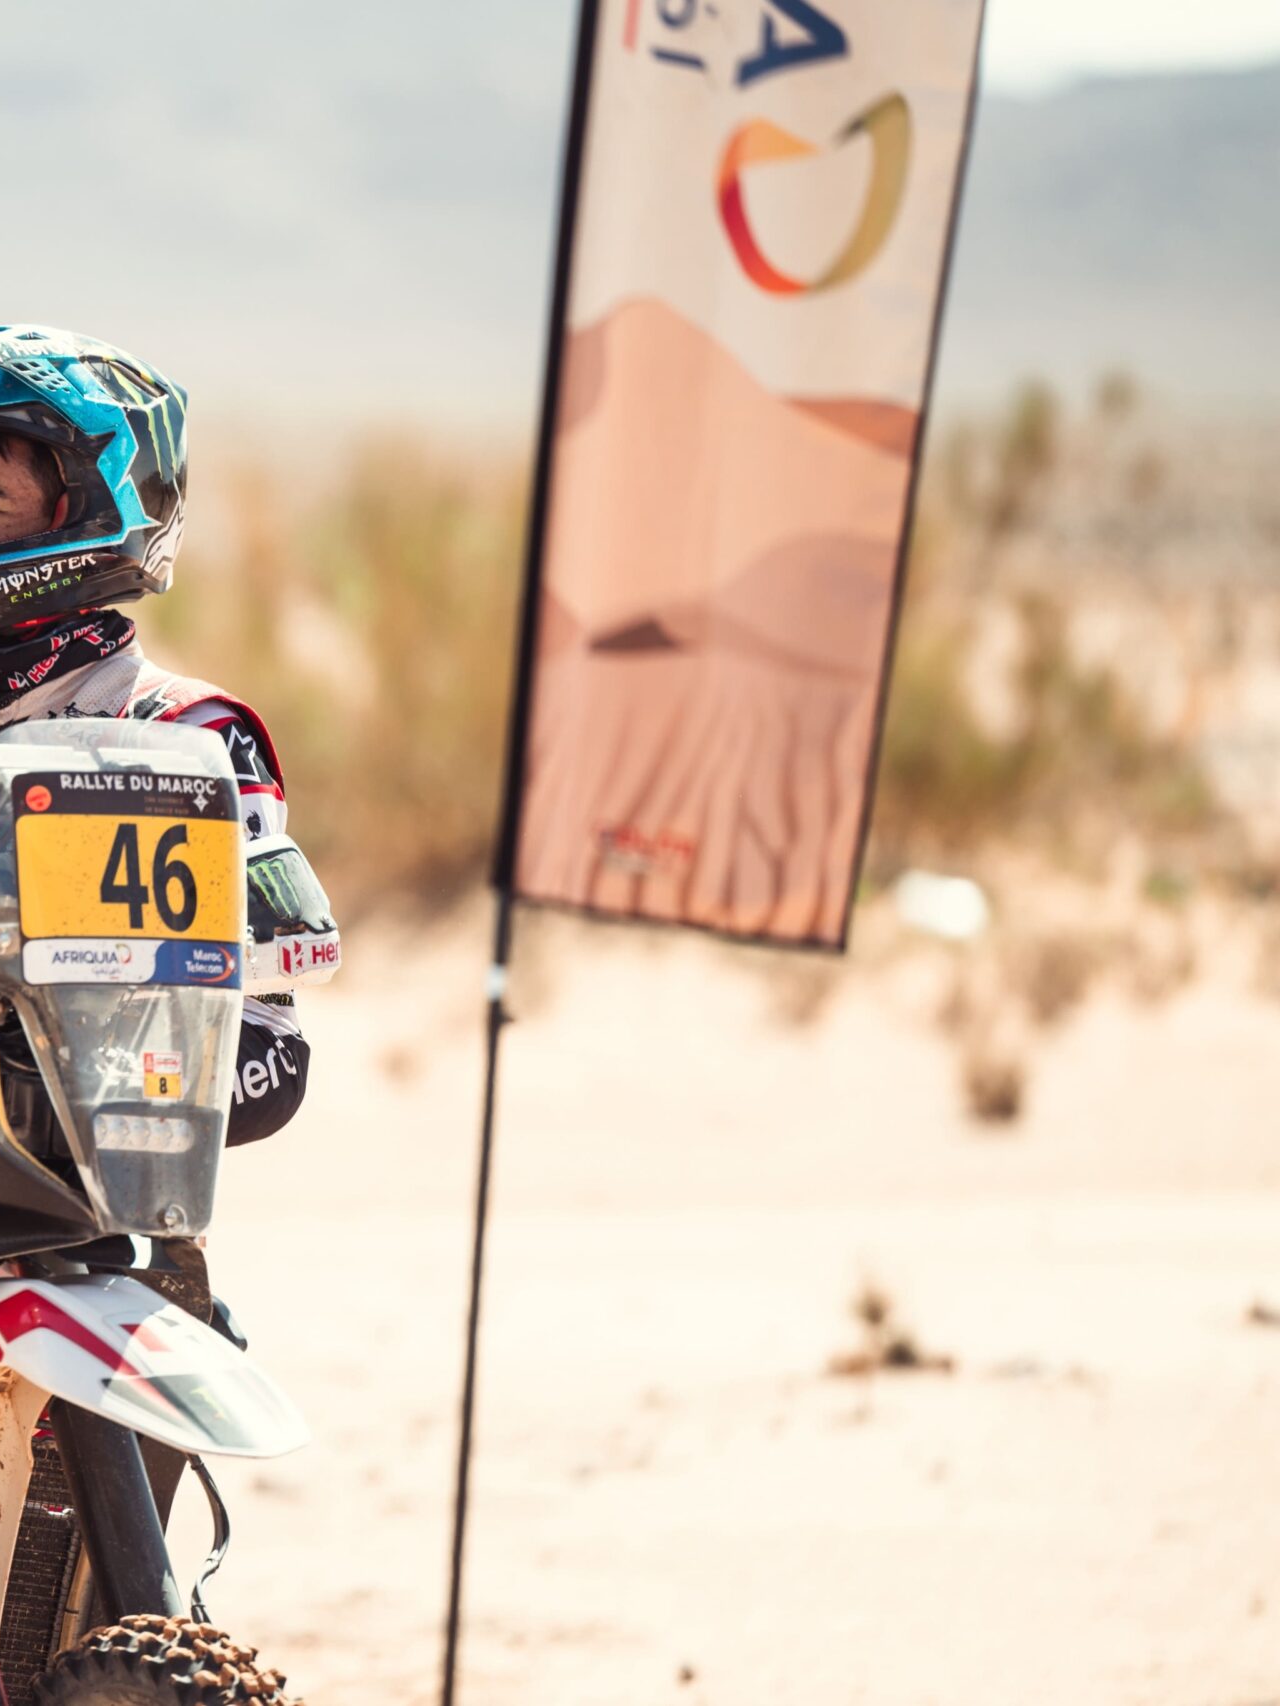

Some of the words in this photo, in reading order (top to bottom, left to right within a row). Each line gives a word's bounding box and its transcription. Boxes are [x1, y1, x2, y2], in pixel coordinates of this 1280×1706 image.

[10, 574, 83, 603] ENERGY
[60, 774, 125, 790] RALLYE
[130, 775, 153, 791] DU
[157, 777, 217, 795] MAROC
[99, 823, 198, 933] 46
[51, 949, 119, 965] AFRIQUIA
[192, 949, 223, 962] Maroc
[184, 960, 224, 974] Telecom
[159, 1076, 168, 1094] 8
